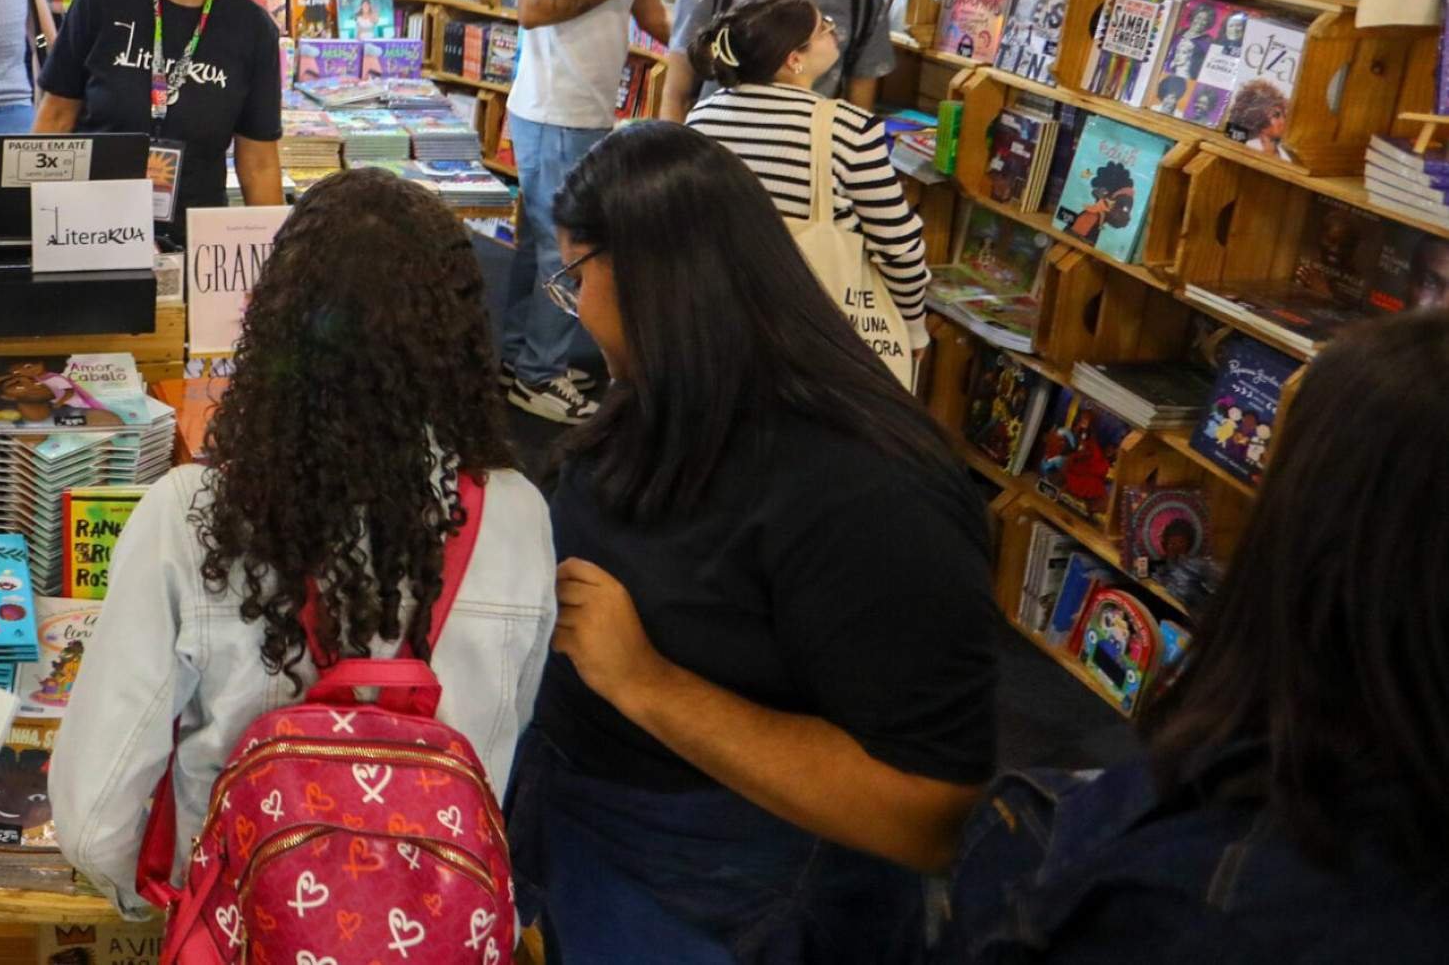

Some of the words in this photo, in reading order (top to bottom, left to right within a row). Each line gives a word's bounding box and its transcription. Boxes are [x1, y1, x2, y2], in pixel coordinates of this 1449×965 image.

[1112, 5, 1150, 35] SAMBA
[125, 21, 228, 89] LitrRUA
[1244, 34, 1297, 85] elza
[8, 141, 44, 150] PAGUE
[47, 141, 65, 150] EM
[68, 140, 87, 150] ATÉ
[36, 153, 58, 168] 3x
[55, 206, 146, 246] LiteraRUA
[193, 242, 275, 295] GRAN
[67, 369, 127, 382] Cabelo
[70, 362, 113, 372] Amor
